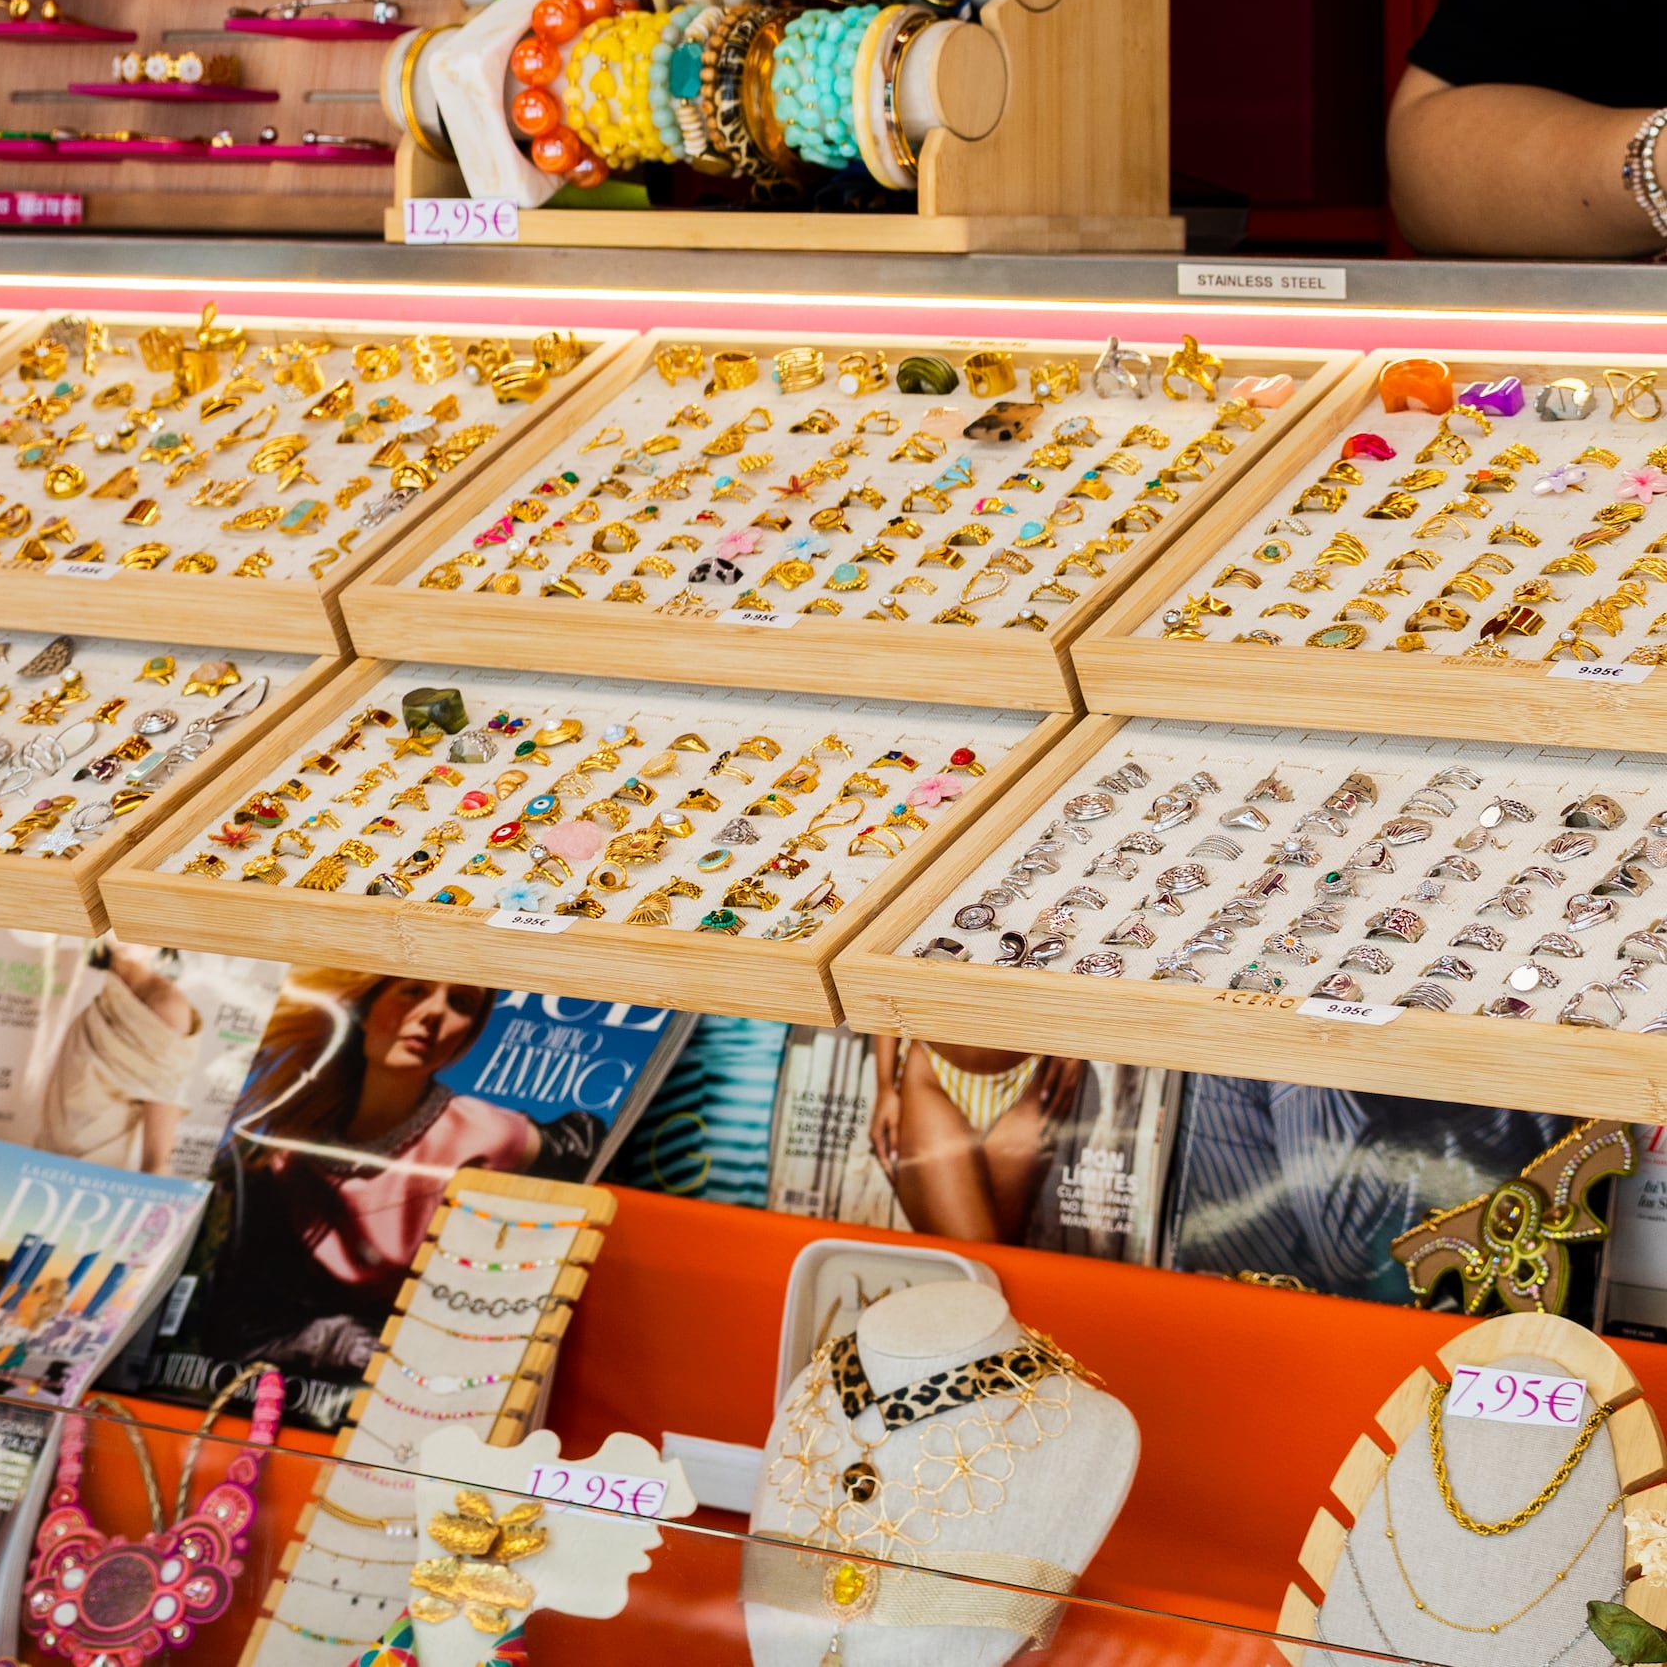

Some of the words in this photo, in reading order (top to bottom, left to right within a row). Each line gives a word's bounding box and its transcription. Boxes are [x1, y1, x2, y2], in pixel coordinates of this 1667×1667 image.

[408, 199, 517, 244] 12,95€
[1197, 274, 1274, 289] STAINLESS
[1280, 276, 1327, 290] STEEL
[651, 604, 718, 618] ACERO
[1213, 991, 1296, 1009] ACERO
[1451, 1368, 1584, 1423] 7,95€
[531, 1468, 665, 1520] 12,95€
